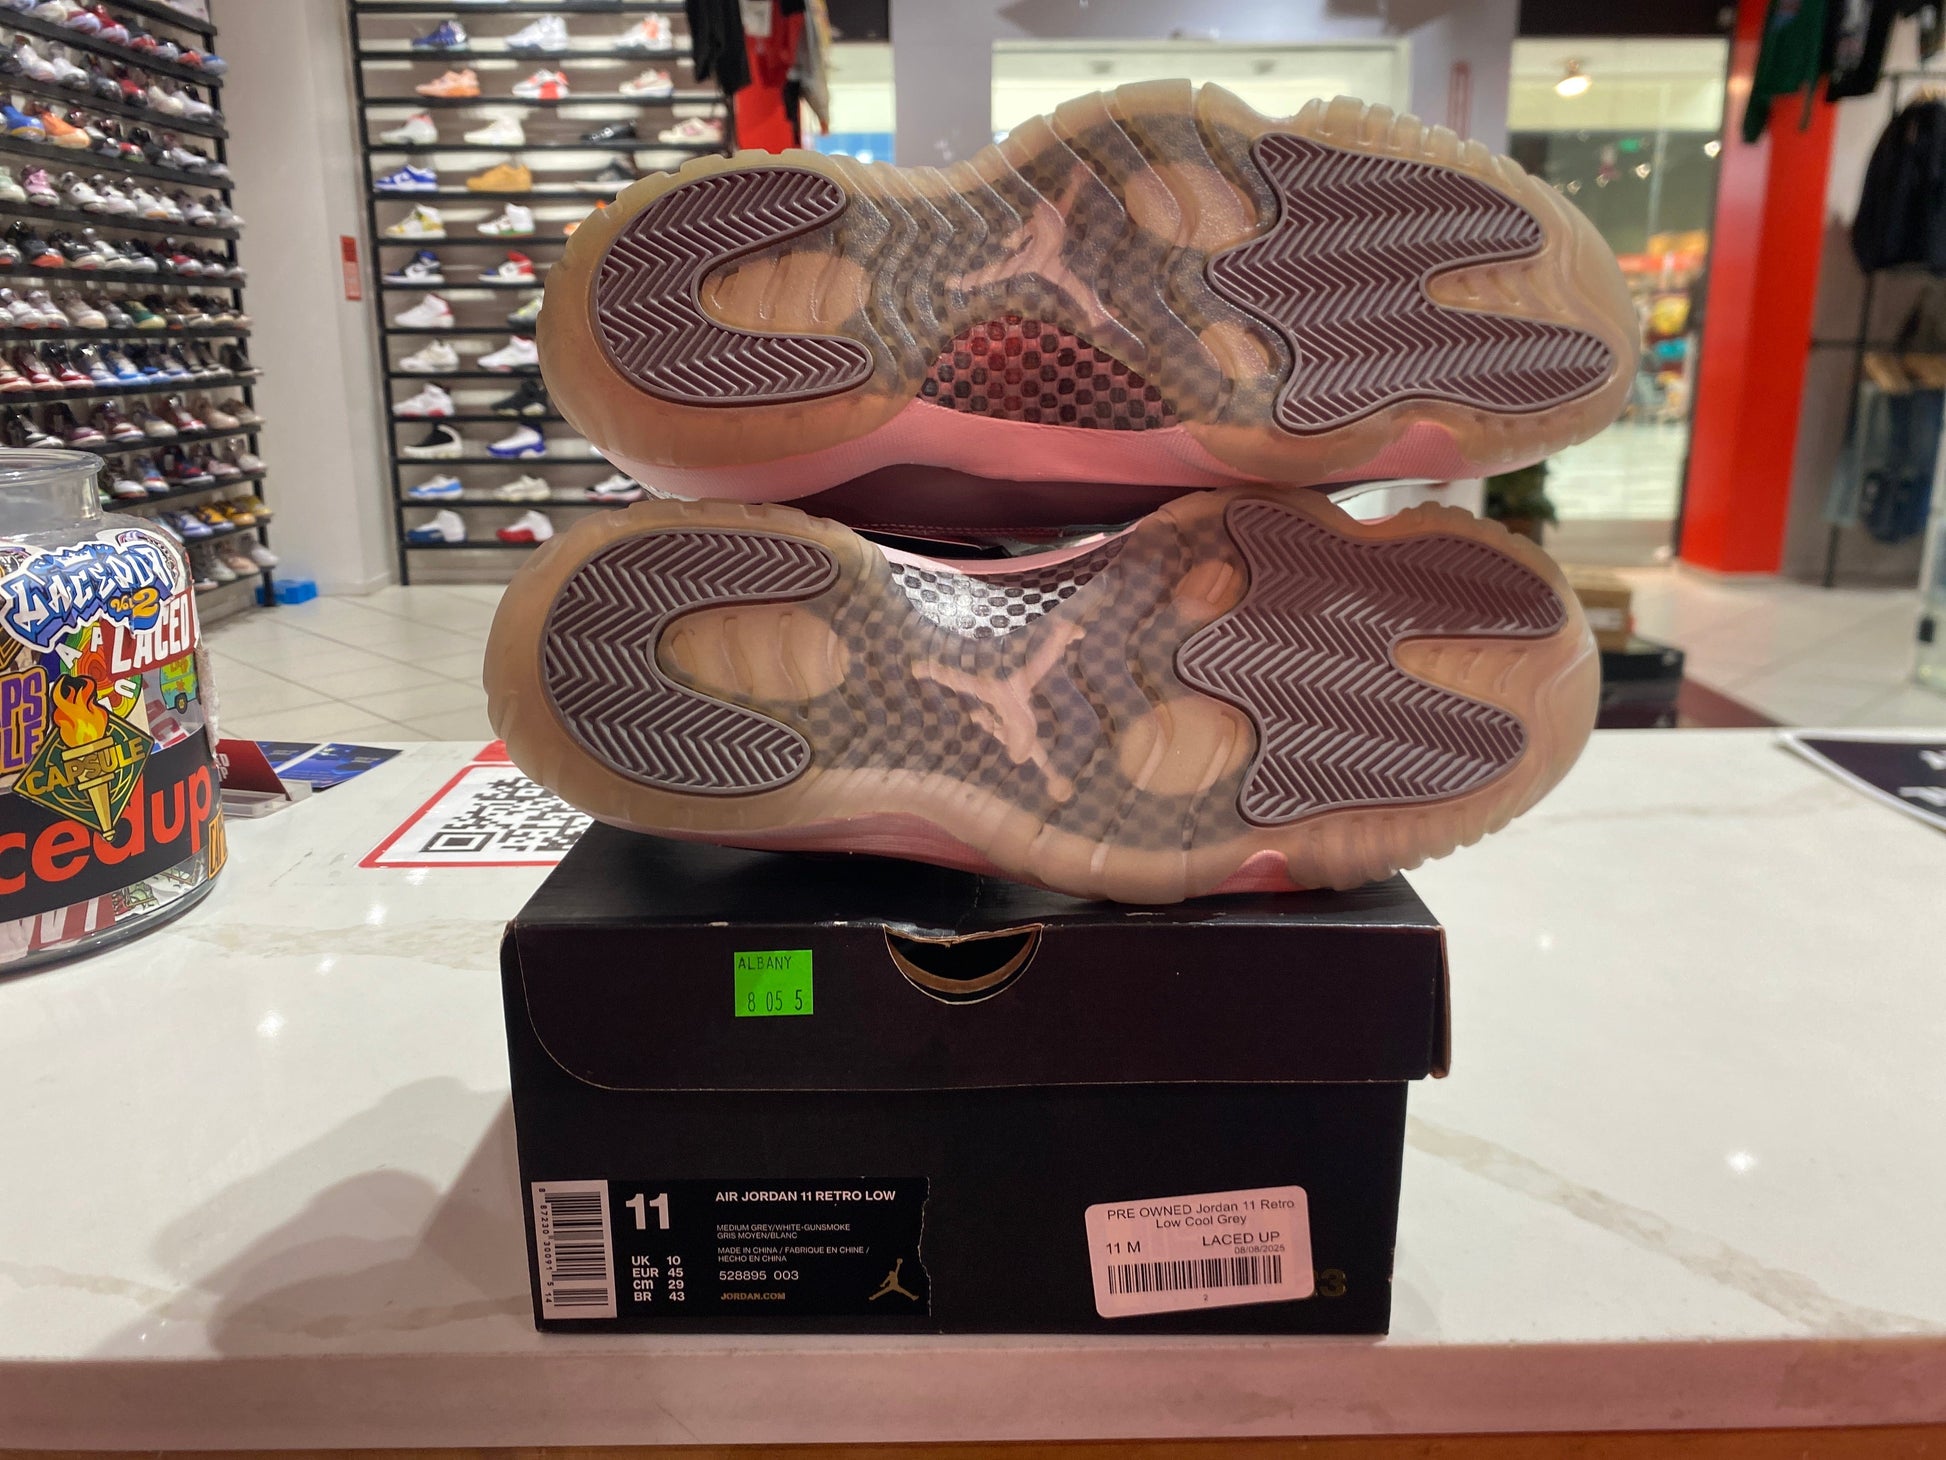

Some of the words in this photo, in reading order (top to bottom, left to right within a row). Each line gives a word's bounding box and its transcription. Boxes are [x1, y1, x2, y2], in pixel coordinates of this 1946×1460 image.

[25, 736, 146, 796] CAPSULE
[738, 956, 792, 970] ALBANY
[748, 992, 755, 1012] 8
[795, 989, 802, 1010] 5
[715, 1191, 738, 1202] AIR
[741, 1191, 797, 1202] JORDAN
[800, 1191, 813, 1201] 11
[815, 1190, 862, 1201] RETRO
[865, 1190, 896, 1201] LOW
[625, 1193, 670, 1230] 11
[1107, 1208, 1135, 1220] PRE
[1139, 1204, 1192, 1218] OWNED
[1196, 1202, 1238, 1214] Jordan
[1243, 1200, 1255, 1210] 11
[1260, 1199, 1295, 1210] Retro
[1156, 1217, 1181, 1229] Low
[1185, 1216, 1213, 1227] Cool
[1217, 1214, 1247, 1226] Grey
[717, 1224, 750, 1232] MEDIUM
[737, 1231, 798, 1239] MOYEN/BLANC
[1202, 1232, 1253, 1246] LACED
[1259, 1231, 1281, 1243] UP
[752, 1246, 778, 1254] CHINA
[784, 1246, 825, 1254] FABRIQUE
[826, 1246, 838, 1254] EN
[839, 1246, 865, 1254] CHINE
[1106, 1243, 1121, 1254] 11
[1127, 1241, 1141, 1253] M
[1234, 1244, 1286, 1255] 08/08/2025
[631, 1255, 650, 1266] UK
[667, 1255, 681, 1266] 10
[632, 1267, 659, 1278] EUR
[667, 1267, 684, 1278] 45
[719, 1271, 766, 1280] 528895
[773, 1271, 799, 1280] 003
[668, 1279, 685, 1290] 29
[634, 1291, 652, 1302] BR
[669, 1291, 686, 1301] 43
[720, 1292, 786, 1300] JORDAN.COM
